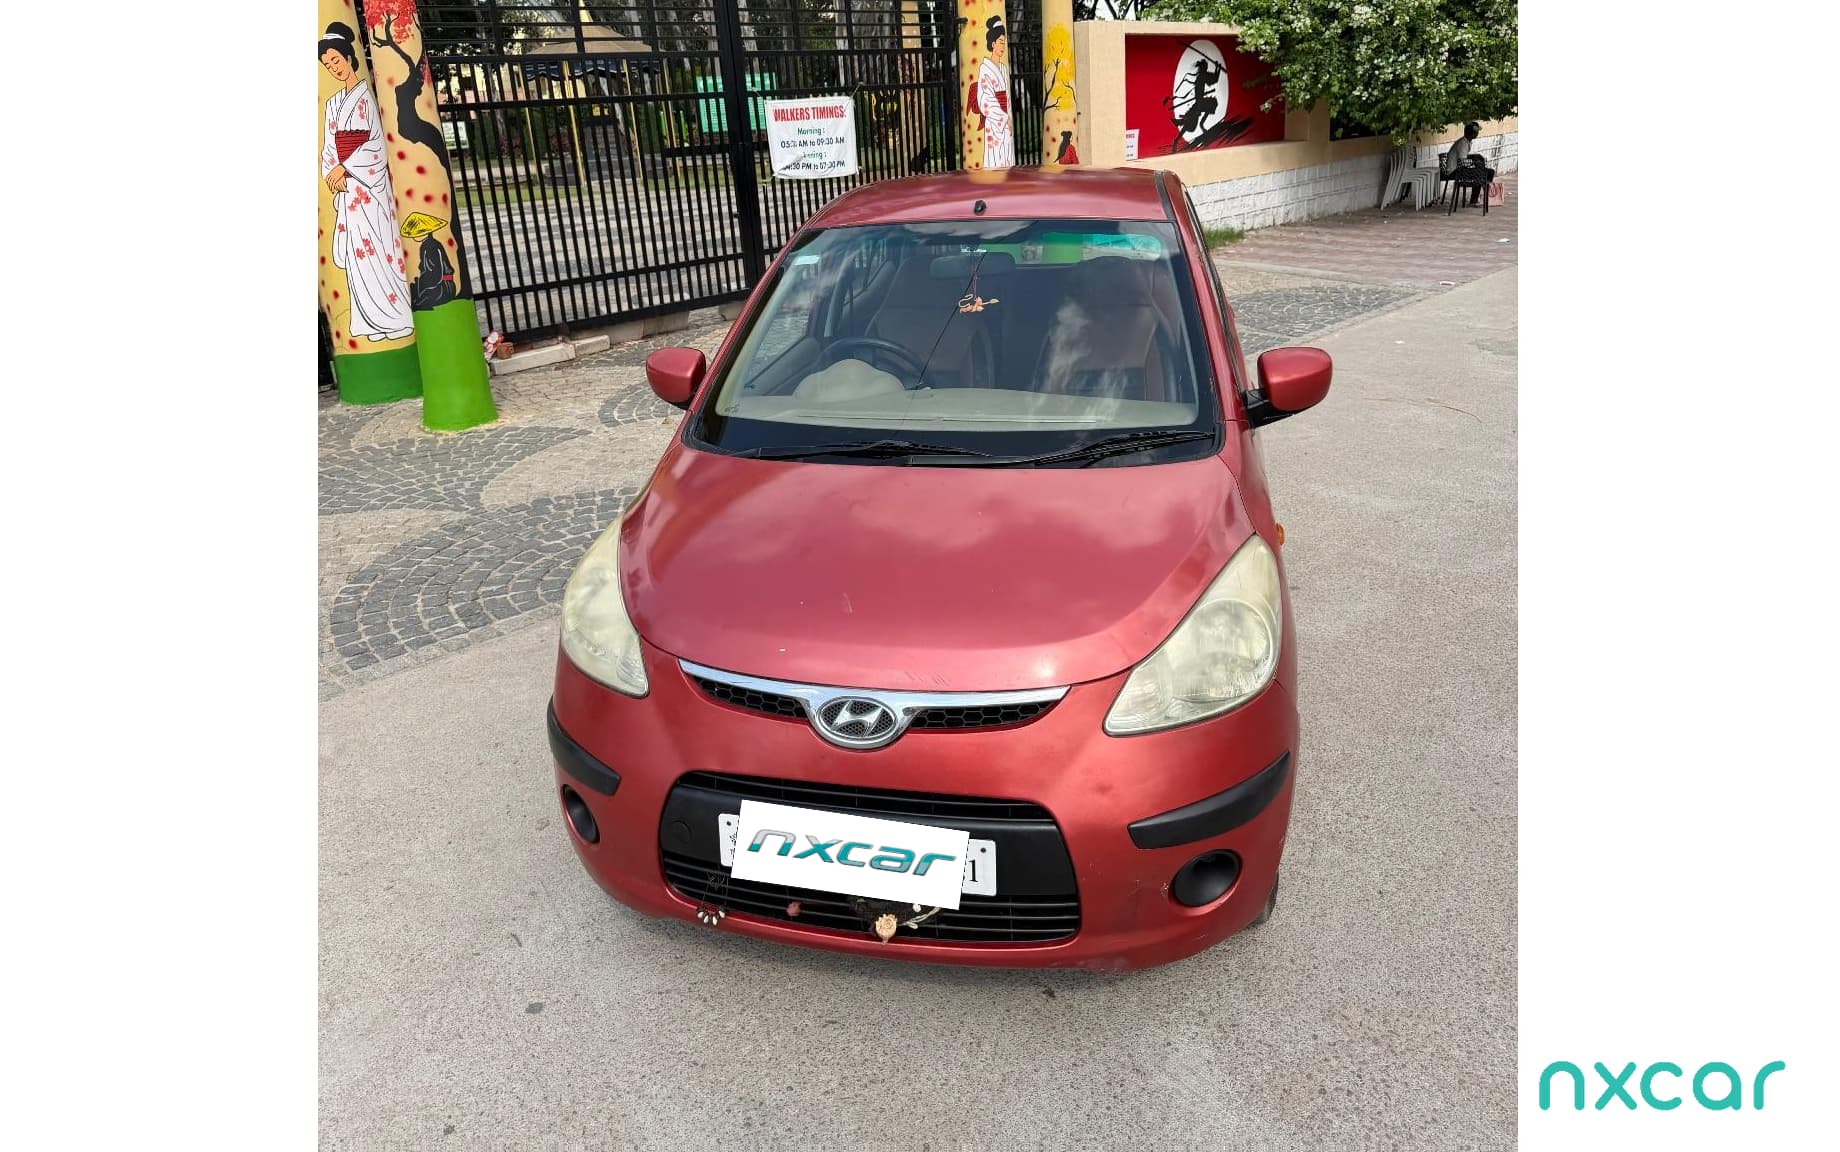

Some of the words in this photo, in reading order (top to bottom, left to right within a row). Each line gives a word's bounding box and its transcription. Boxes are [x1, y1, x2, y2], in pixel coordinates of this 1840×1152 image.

[773, 107, 810, 122] WALKERS
[797, 127, 822, 136] Morning
[798, 139, 808, 147] AM
[809, 139, 816, 147] to
[835, 136, 845, 144] AM
[801, 162, 812, 170] PM
